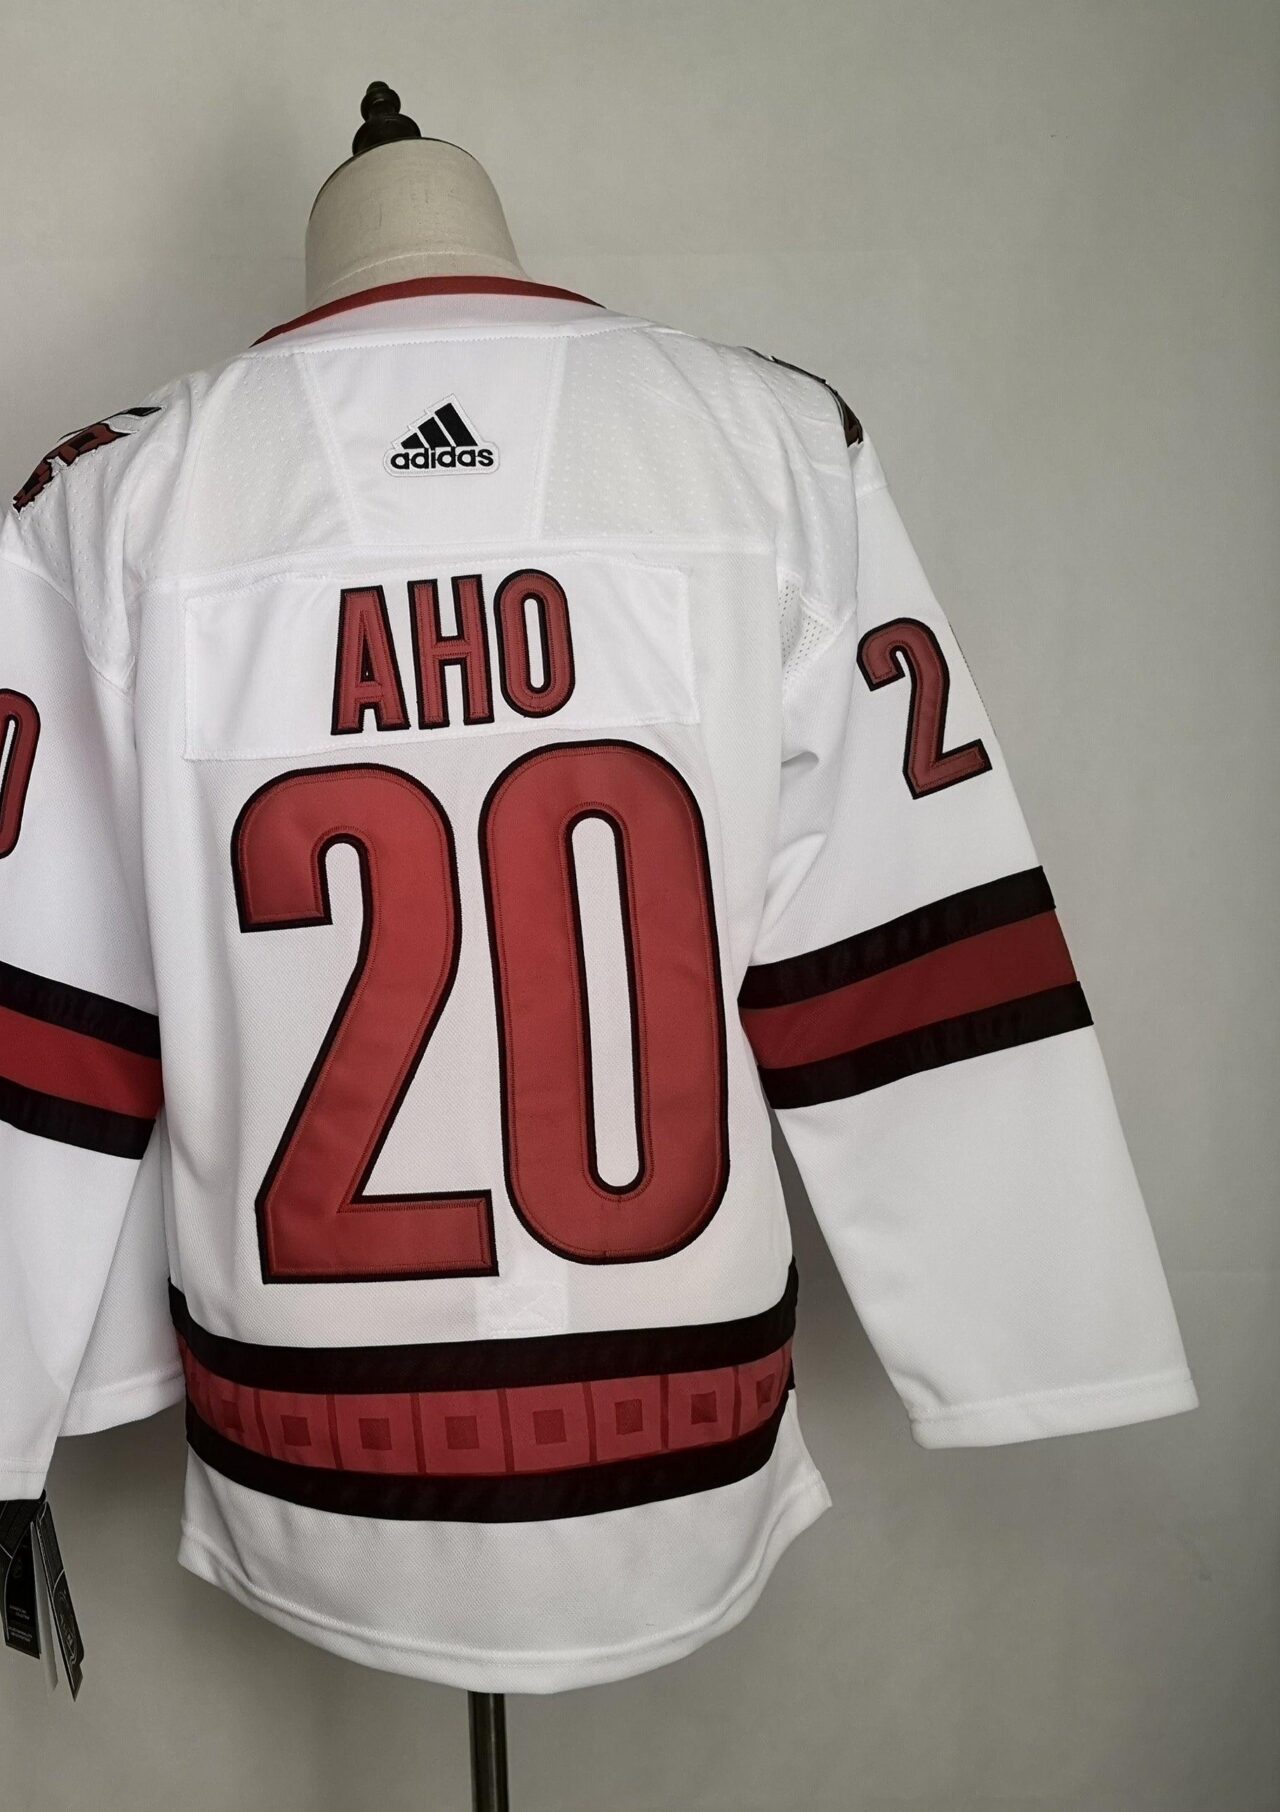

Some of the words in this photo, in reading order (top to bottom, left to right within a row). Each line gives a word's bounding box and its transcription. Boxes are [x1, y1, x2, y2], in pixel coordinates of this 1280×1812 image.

[390, 446, 494, 470] adidas
[330, 568, 576, 735] AHO
[856, 617, 993, 800] 2
[229, 738, 731, 1286] 20
